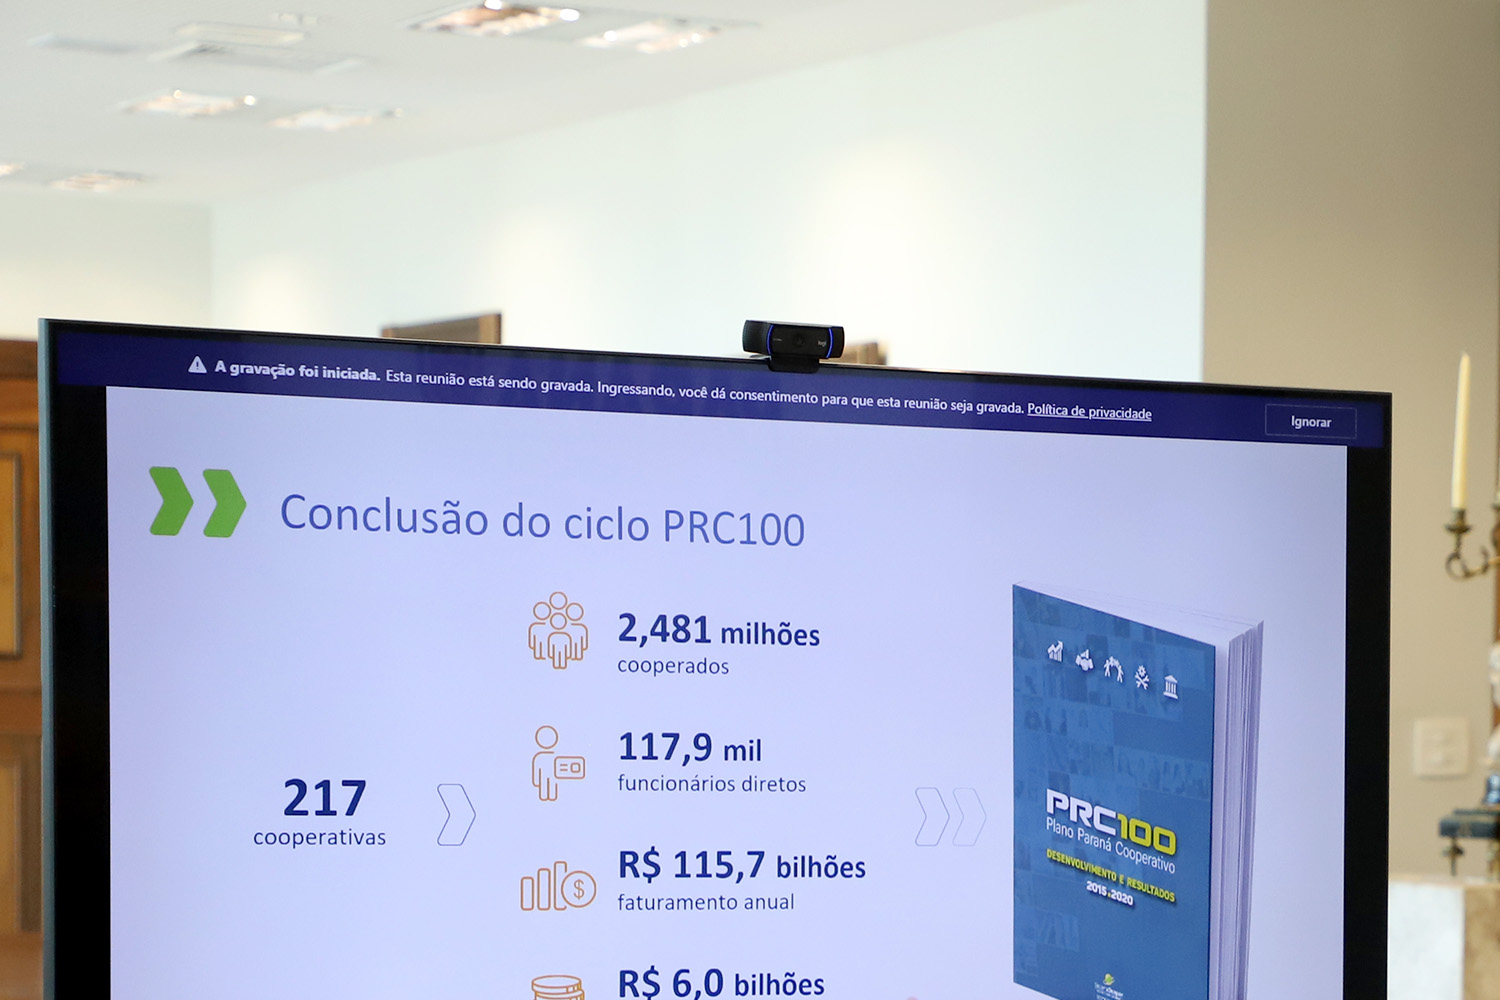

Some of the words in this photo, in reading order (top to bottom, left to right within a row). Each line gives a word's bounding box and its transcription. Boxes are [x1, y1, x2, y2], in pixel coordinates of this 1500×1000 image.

[214, 360, 227, 373] A
[229, 361, 296, 381] gravação
[298, 364, 319, 378] foi
[322, 365, 382, 382] iniciada.
[385, 369, 413, 384] Esta
[415, 371, 465, 387] reunião
[468, 374, 496, 389] está
[498, 376, 537, 391] sendo
[540, 379, 595, 396] gravada.
[597, 380, 676, 400] Ingressando,
[678, 384, 708, 400] você
[710, 387, 727, 401] dá
[729, 389, 819, 405] consentimento
[821, 394, 848, 408] para
[850, 397, 875, 410] que
[876, 396, 901, 409] esta
[904, 396, 948, 411] reunião
[950, 399, 974, 415] seja
[976, 401, 1025, 416] gravada.
[1027, 402, 1068, 418] Política
[1070, 405, 1085, 419] de
[1087, 406, 1152, 422] privacidade
[1290, 414, 1332, 430] Ignorar
[280, 493, 489, 536] Conclusão
[502, 501, 551, 538] do
[564, 505, 651, 542] ciclo
[664, 509, 806, 547] PRC100
[618, 612, 713, 649] 2,481
[721, 621, 821, 647] milhões
[617, 657, 730, 677] cooperados
[619, 731, 713, 767] 117,9
[723, 738, 762, 763] mil
[282, 778, 367, 817] 217
[617, 773, 737, 793] funcionários
[741, 774, 807, 793] diretos
[253, 828, 387, 850] cooperativas
[1046, 788, 1177, 856] PRC100
[1046, 816, 1074, 839] Plano
[1077, 827, 1112, 852] Paraná
[1115, 841, 1176, 875] Cooperativo
[619, 845, 662, 884] R$
[673, 850, 766, 884] 115,7
[776, 854, 867, 880] bilhões
[1046, 848, 1117, 882] DESENVOLVIMENTO
[1119, 874, 1125, 885] E
[1126, 877, 1176, 903] RESULTADOS
[617, 893, 739, 911] faturamento
[744, 892, 795, 911] anual
[734, 971, 826, 998] bilhões
